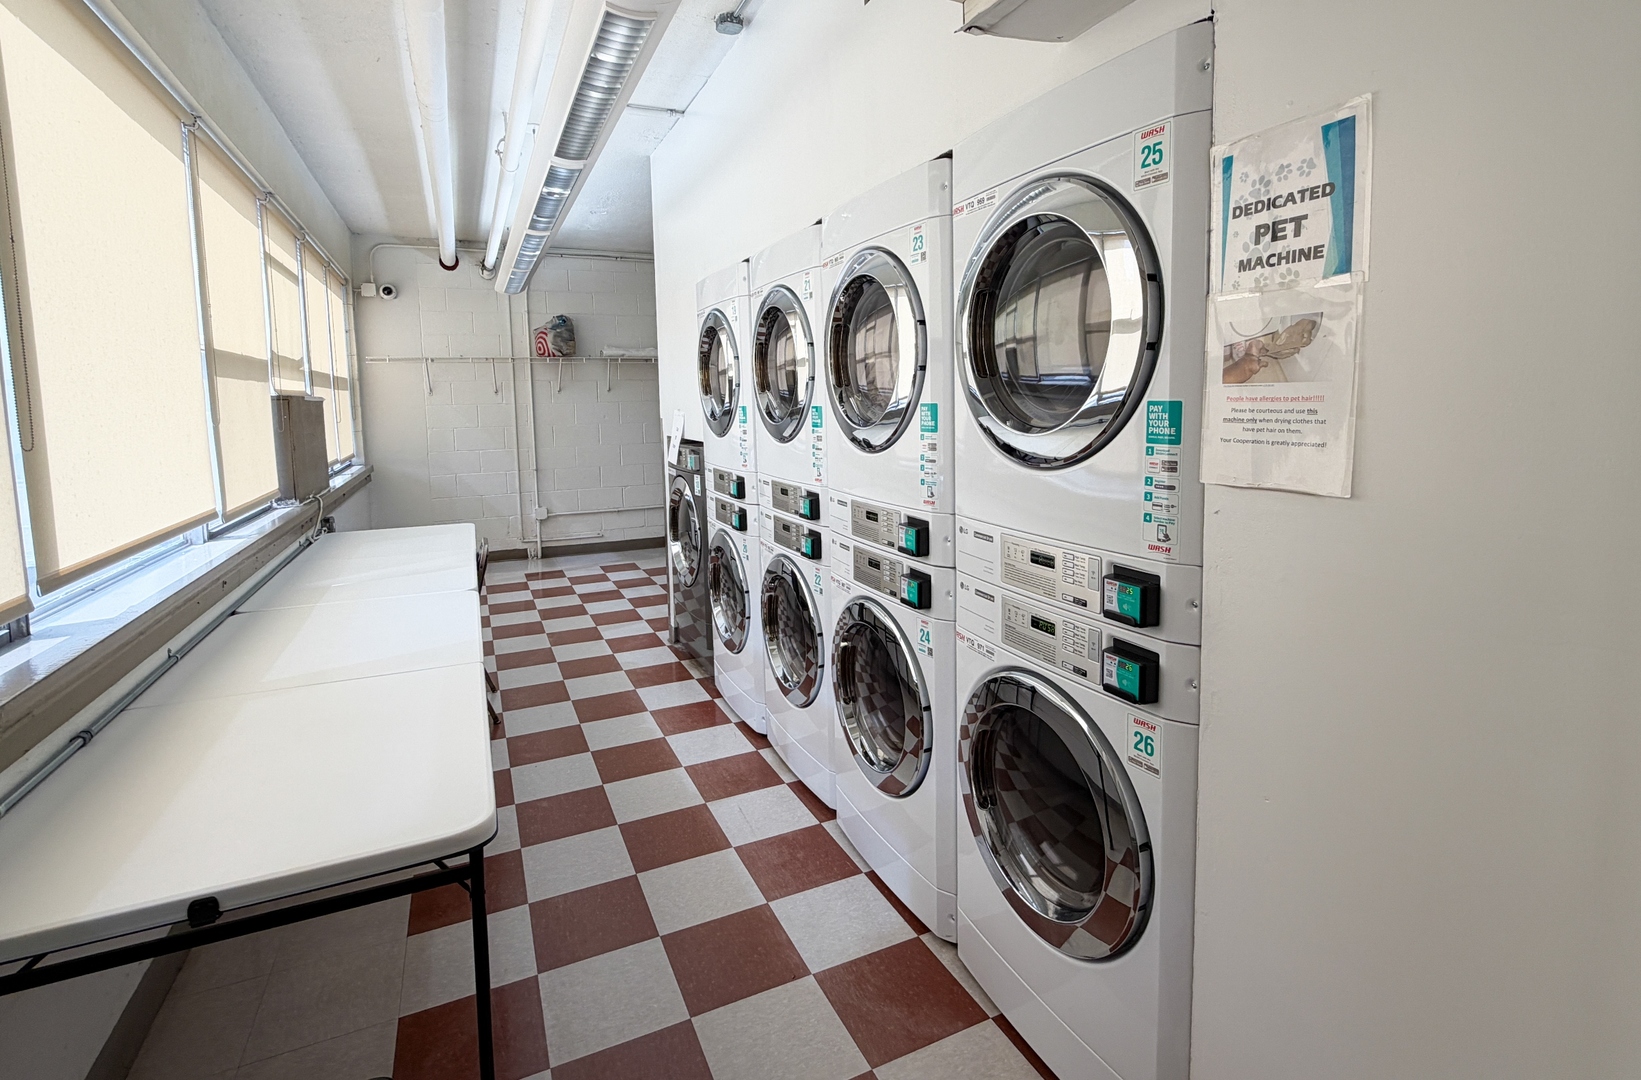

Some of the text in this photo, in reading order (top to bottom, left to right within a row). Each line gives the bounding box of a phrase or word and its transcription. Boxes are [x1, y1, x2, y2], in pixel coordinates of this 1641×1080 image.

[1141, 125, 1165, 140] WASH
[1141, 141, 1163, 169] 25
[1232, 182, 1335, 219] DEDICATED
[1254, 214, 1308, 247] PET
[913, 235, 923, 252] 23
[1238, 244, 1325, 273] MACHINE
[1149, 427, 1176, 435] PHONE
[1148, 544, 1171, 553] WASH
[1126, 587, 1133, 595] 25
[920, 628, 930, 644] 24
[956, 631, 965, 641] ASH
[1125, 663, 1132, 672] 26
[1133, 718, 1156, 731] WASH
[1134, 731, 1154, 757] 26
